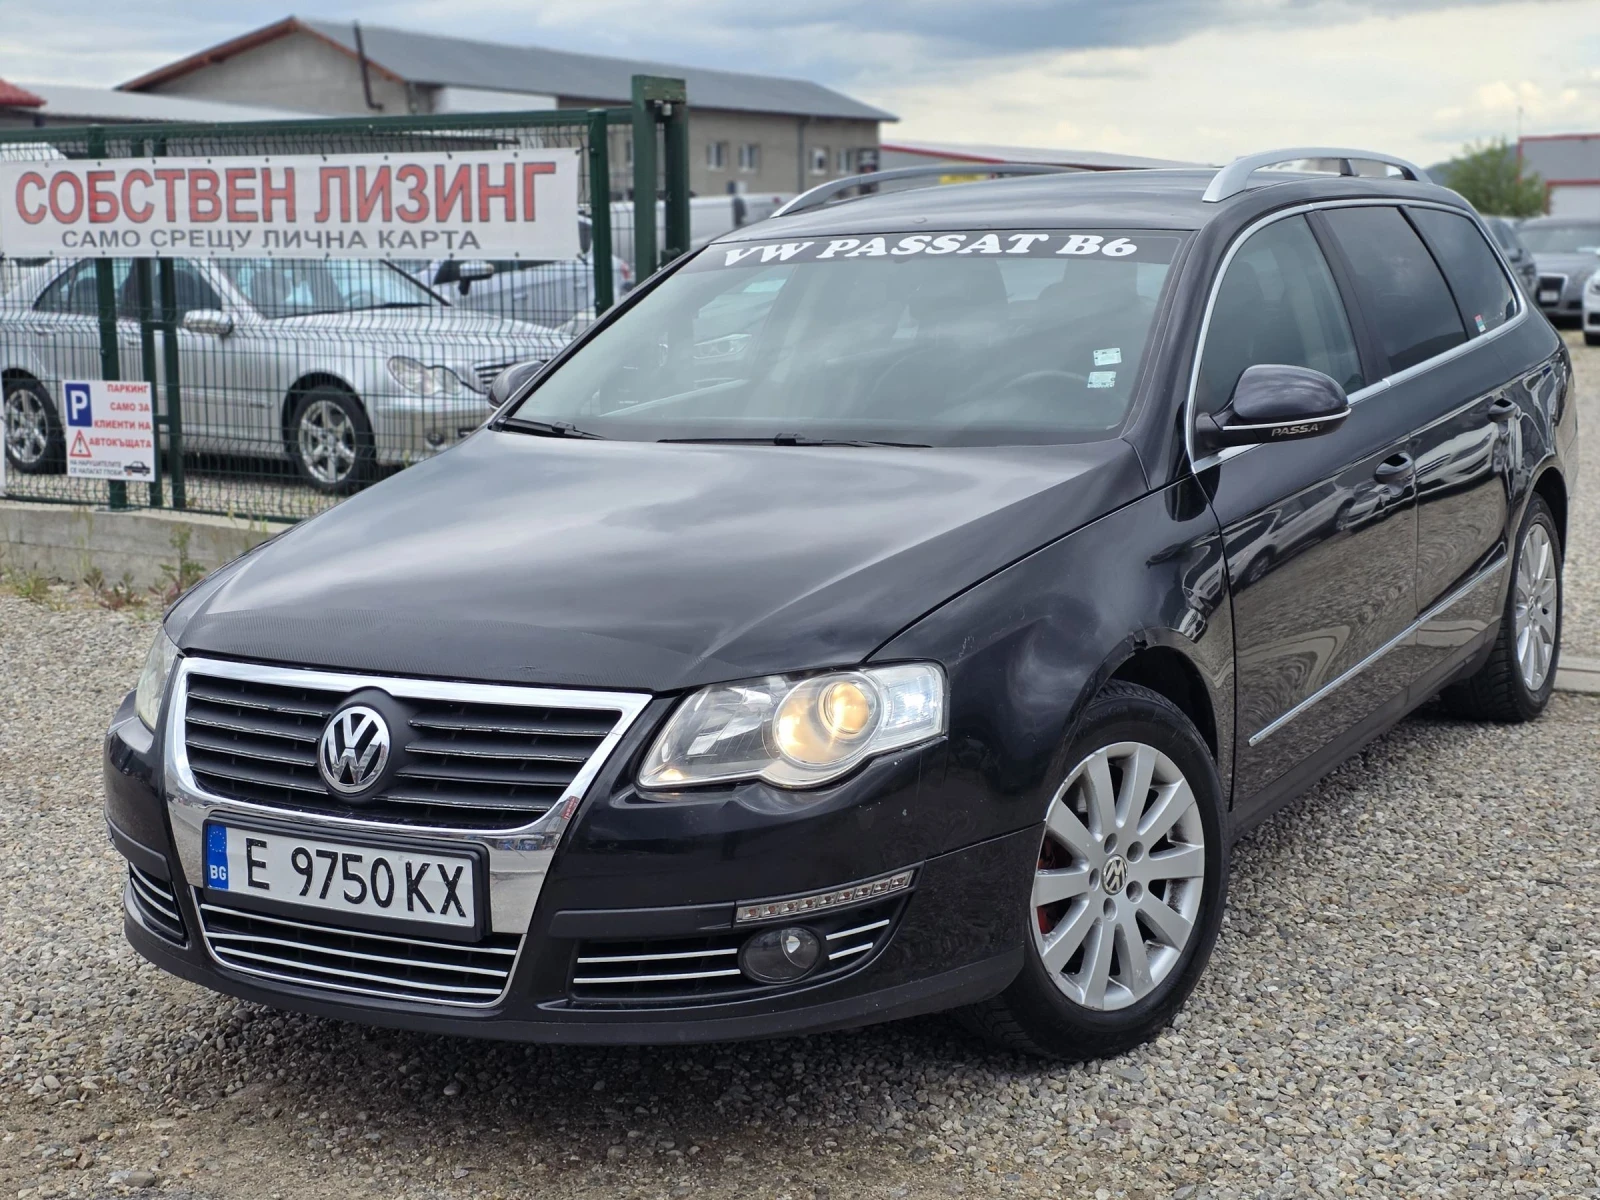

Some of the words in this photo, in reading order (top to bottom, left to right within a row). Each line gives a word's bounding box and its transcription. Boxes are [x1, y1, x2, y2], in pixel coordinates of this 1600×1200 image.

[15, 167, 297, 225] СОБСТВЕН
[314, 161, 557, 224] ЛИЗИНГ
[61, 229, 141, 248] САМО
[150, 229, 252, 250] СРЕЩУ
[261, 229, 368, 249] ЛИЧНА
[378, 229, 481, 249] КАРТА
[724, 241, 815, 267] VW
[815, 233, 1050, 259] PASSAT
[1055, 234, 1138, 257] B6
[107, 384, 148, 394] ПАРКИНГ
[70, 390, 88, 421] P
[110, 401, 136, 412] САМО
[138, 402, 150, 412] ЗА
[93, 419, 136, 430] КЛИЕНТИ
[139, 421, 151, 430] НА
[89, 436, 152, 449] АВТОКЪЩАТА
[209, 864, 227, 881] BG
[245, 837, 270, 891] E
[291, 846, 395, 909] 9750
